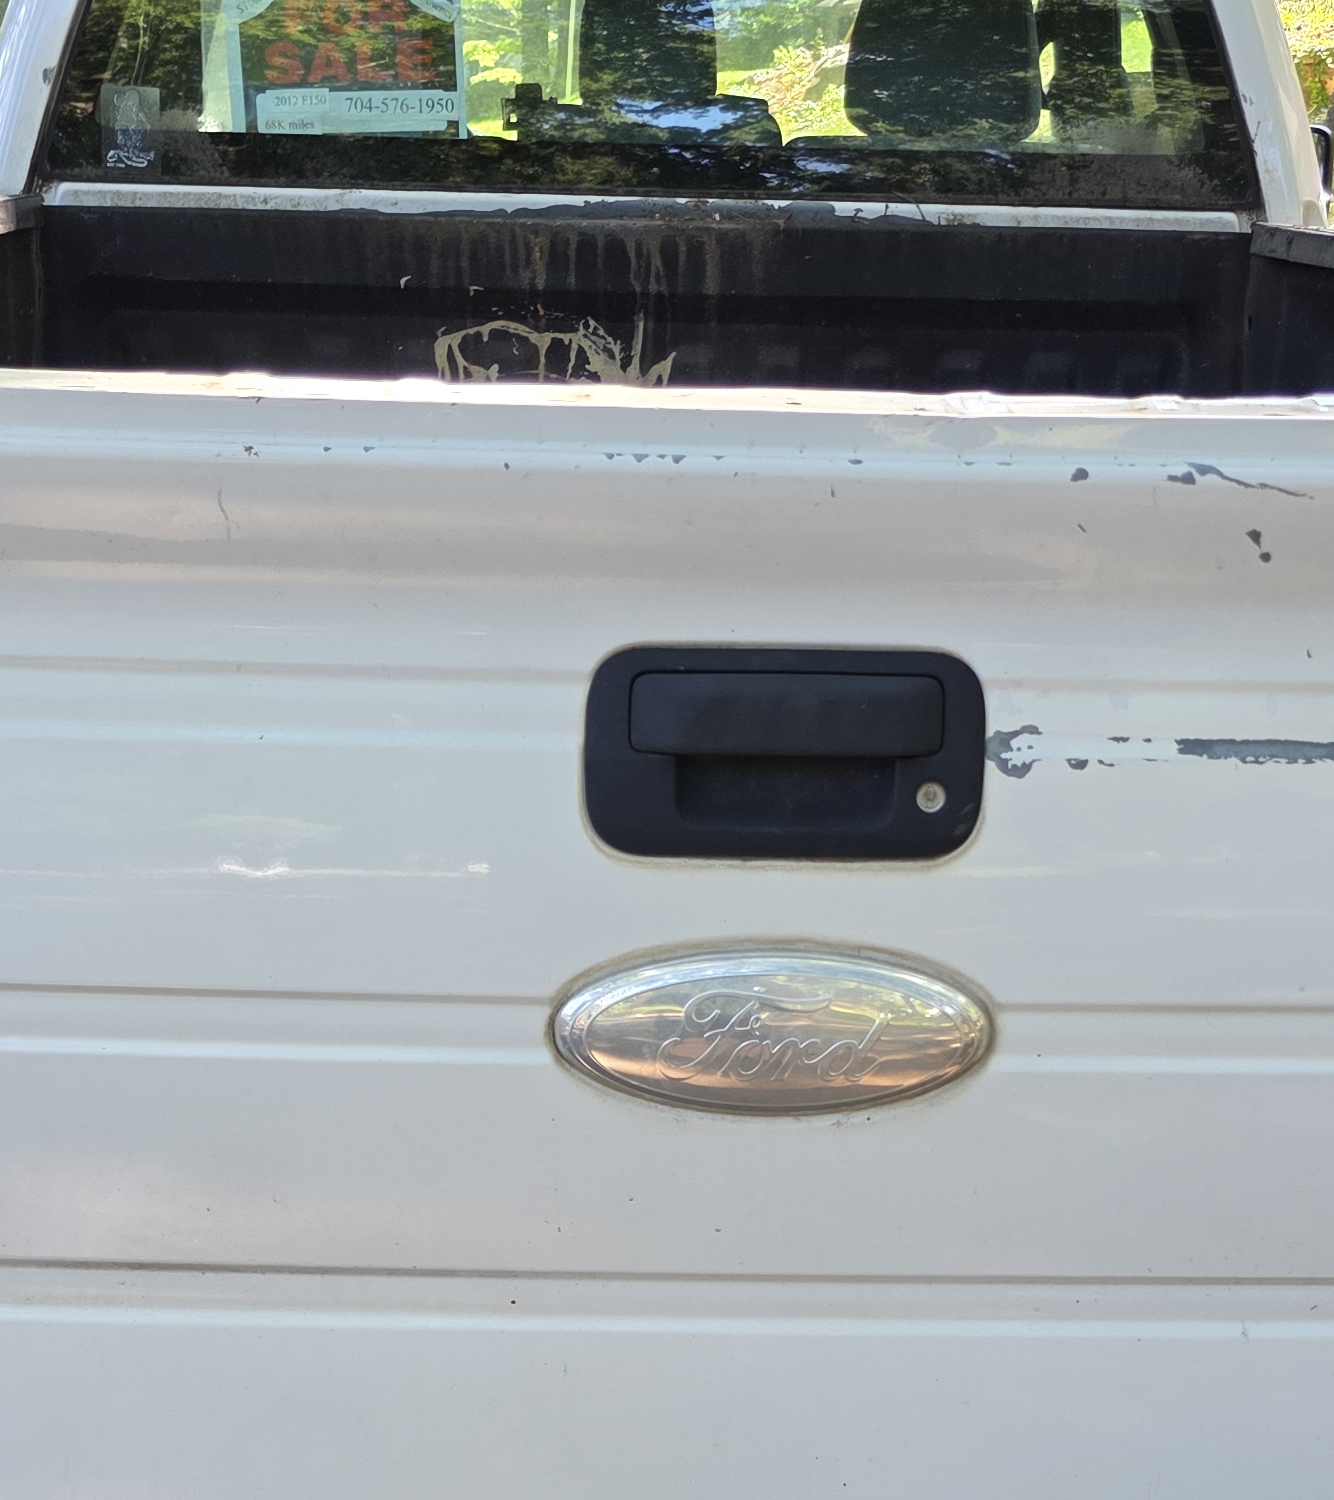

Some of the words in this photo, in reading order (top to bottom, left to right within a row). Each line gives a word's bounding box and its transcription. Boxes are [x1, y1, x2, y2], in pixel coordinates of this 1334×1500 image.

[283, 0, 408, 36] FOR
[264, 40, 437, 85] SALE
[274, 96, 298, 107] 2012
[300, 95, 327, 106] F150
[344, 97, 455, 114] 704-576-1950
[264, 120, 285, 131] 68K
[288, 119, 315, 131] miles
[656, 988, 894, 1082] Ford
